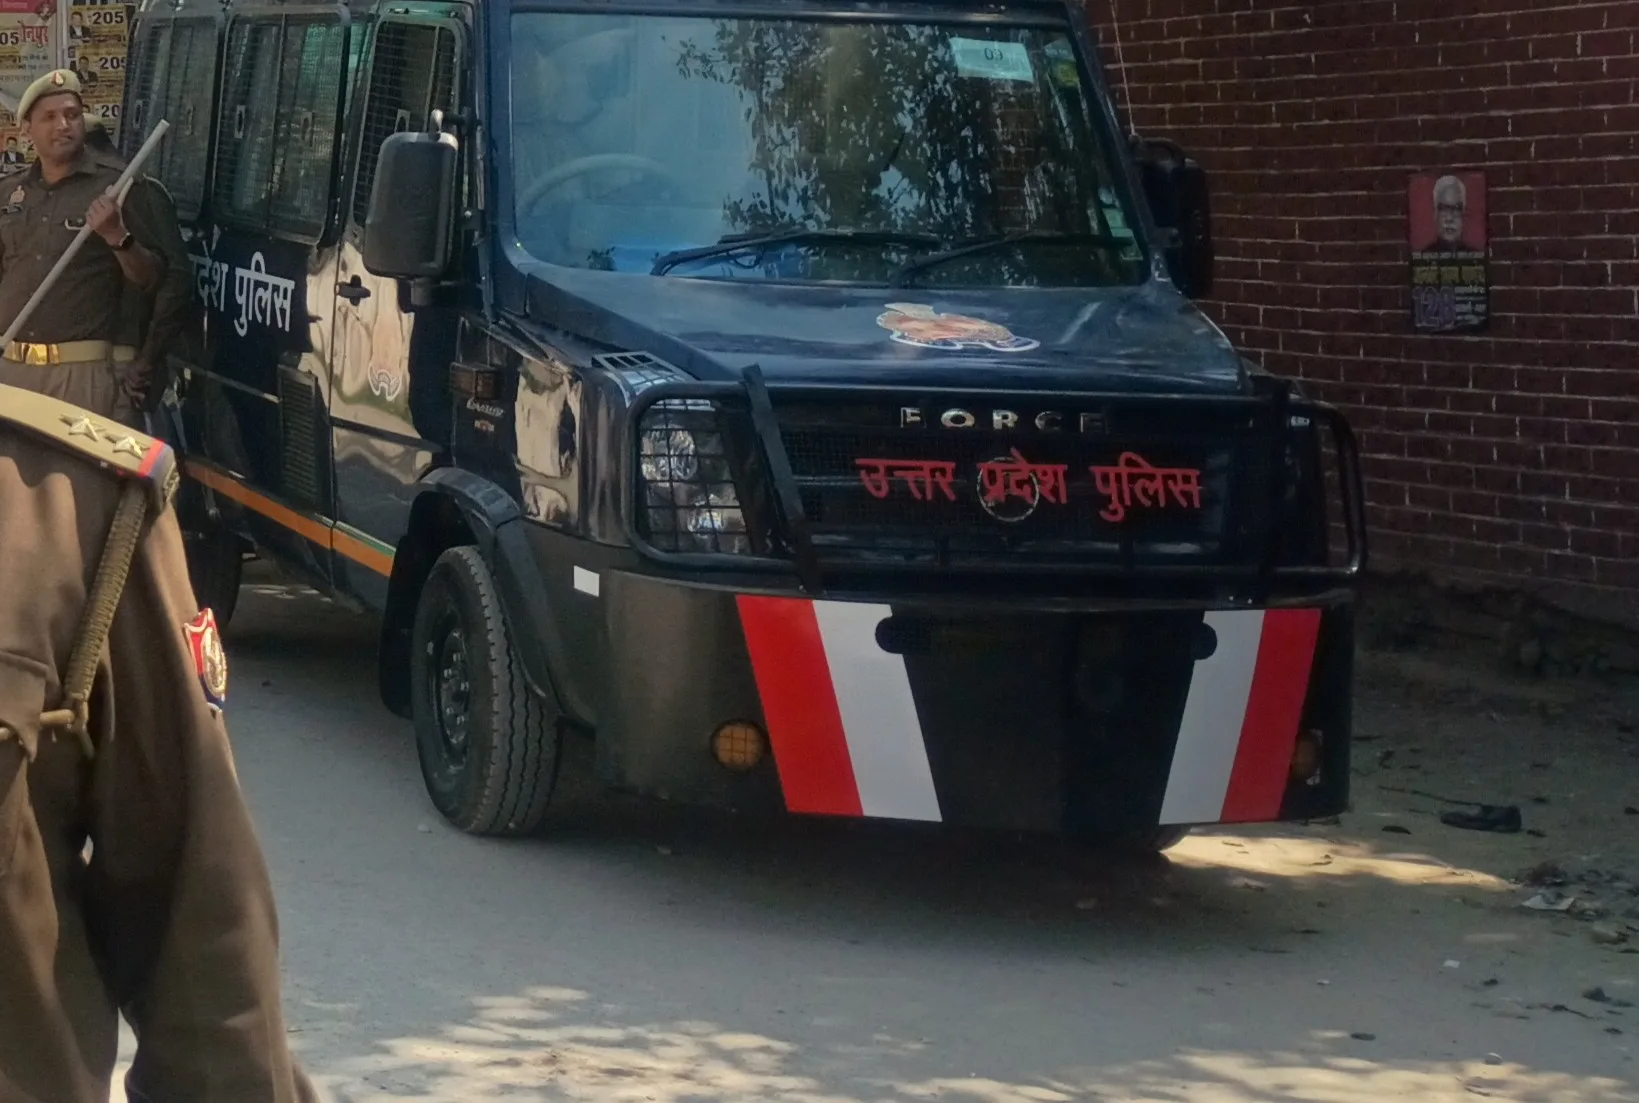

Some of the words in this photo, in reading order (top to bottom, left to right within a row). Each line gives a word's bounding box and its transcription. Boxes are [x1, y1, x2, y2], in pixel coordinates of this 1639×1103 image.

[92, 11, 124, 24] 205
[188, 239, 228, 313] देश
[233, 251, 296, 338] पुलिस
[899, 406, 1109, 434] FORCE
[855, 458, 956, 501] उत्तर
[976, 447, 1068, 505] प्रदेश
[1089, 451, 1202, 523] पुलिस
